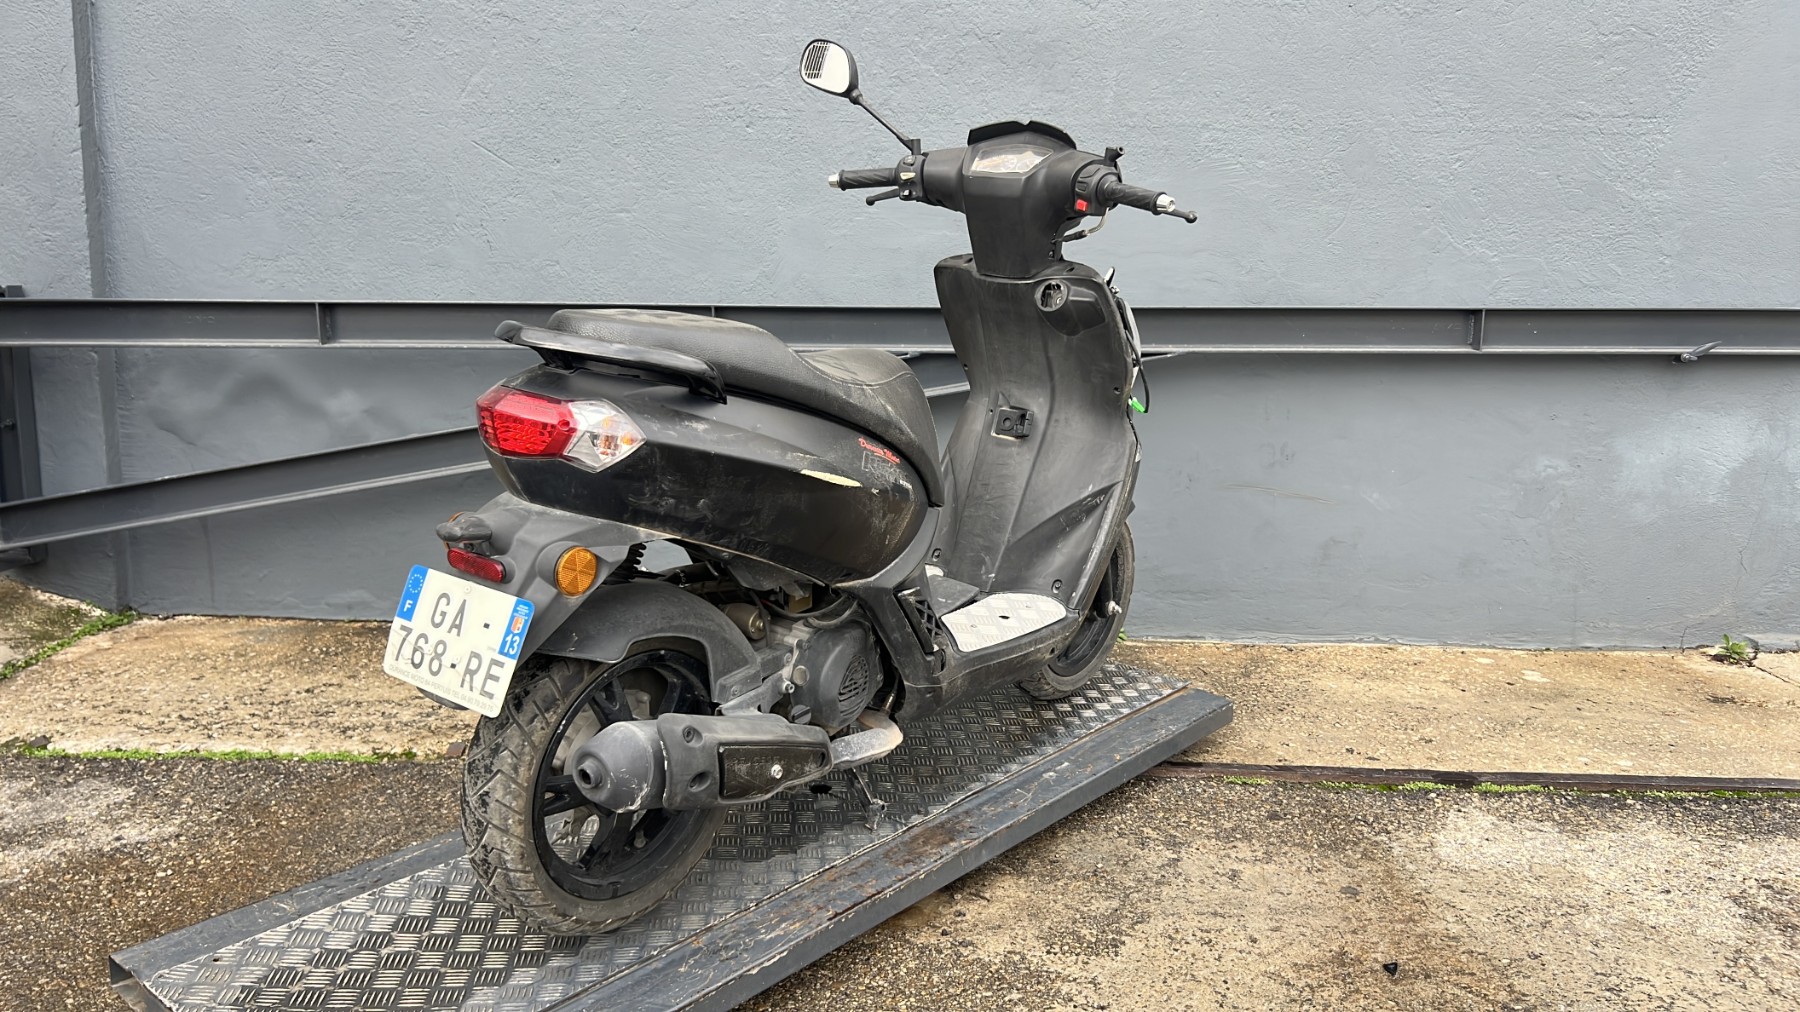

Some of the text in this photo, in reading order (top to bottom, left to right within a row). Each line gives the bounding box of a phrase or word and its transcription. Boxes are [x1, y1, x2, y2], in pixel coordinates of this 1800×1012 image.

[403, 600, 413, 612] F
[430, 592, 467, 637] GA
[503, 633, 520, 655] 13
